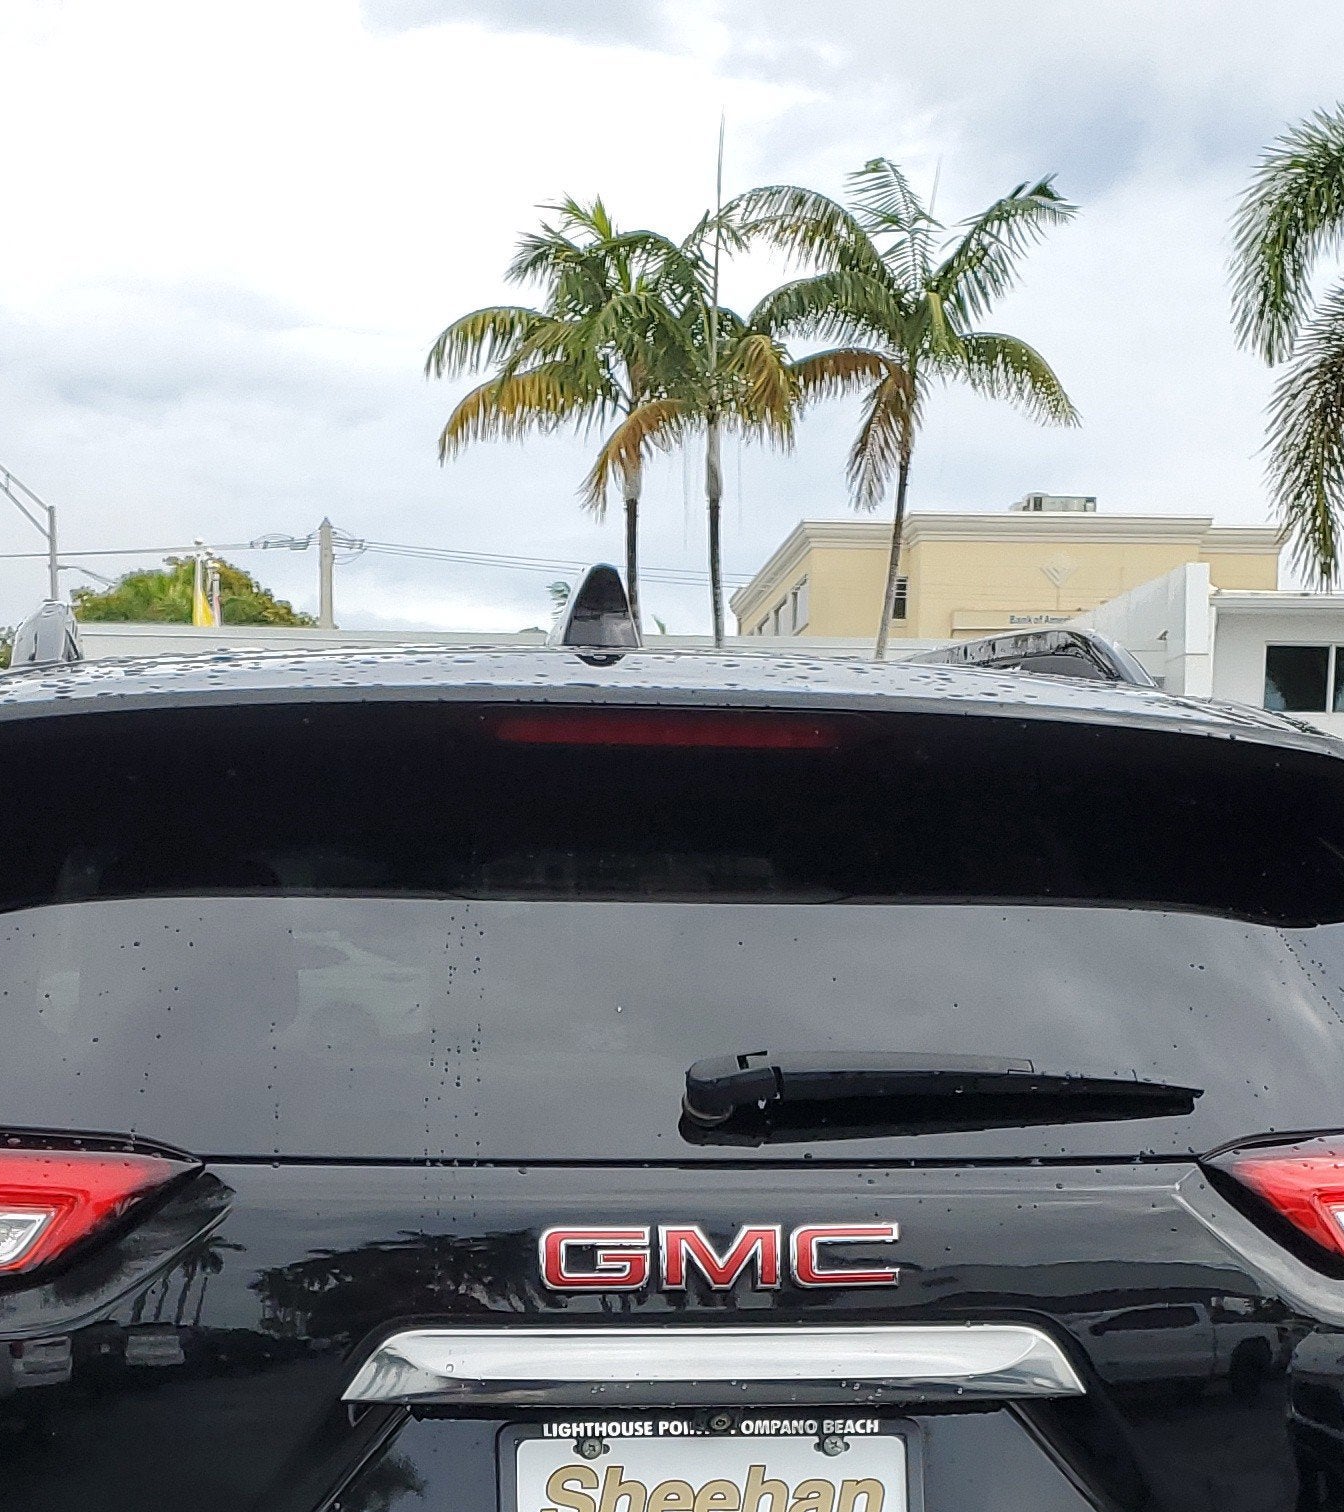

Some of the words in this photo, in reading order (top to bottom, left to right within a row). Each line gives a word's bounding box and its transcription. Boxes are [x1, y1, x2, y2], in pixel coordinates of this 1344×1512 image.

[539, 1222, 899, 1291] GMC
[543, 1420, 653, 1437] LIGHTHOUSE
[658, 1420, 711, 1436] POI
[730, 1419, 818, 1435] OMPANO
[823, 1418, 879, 1434] BEACH
